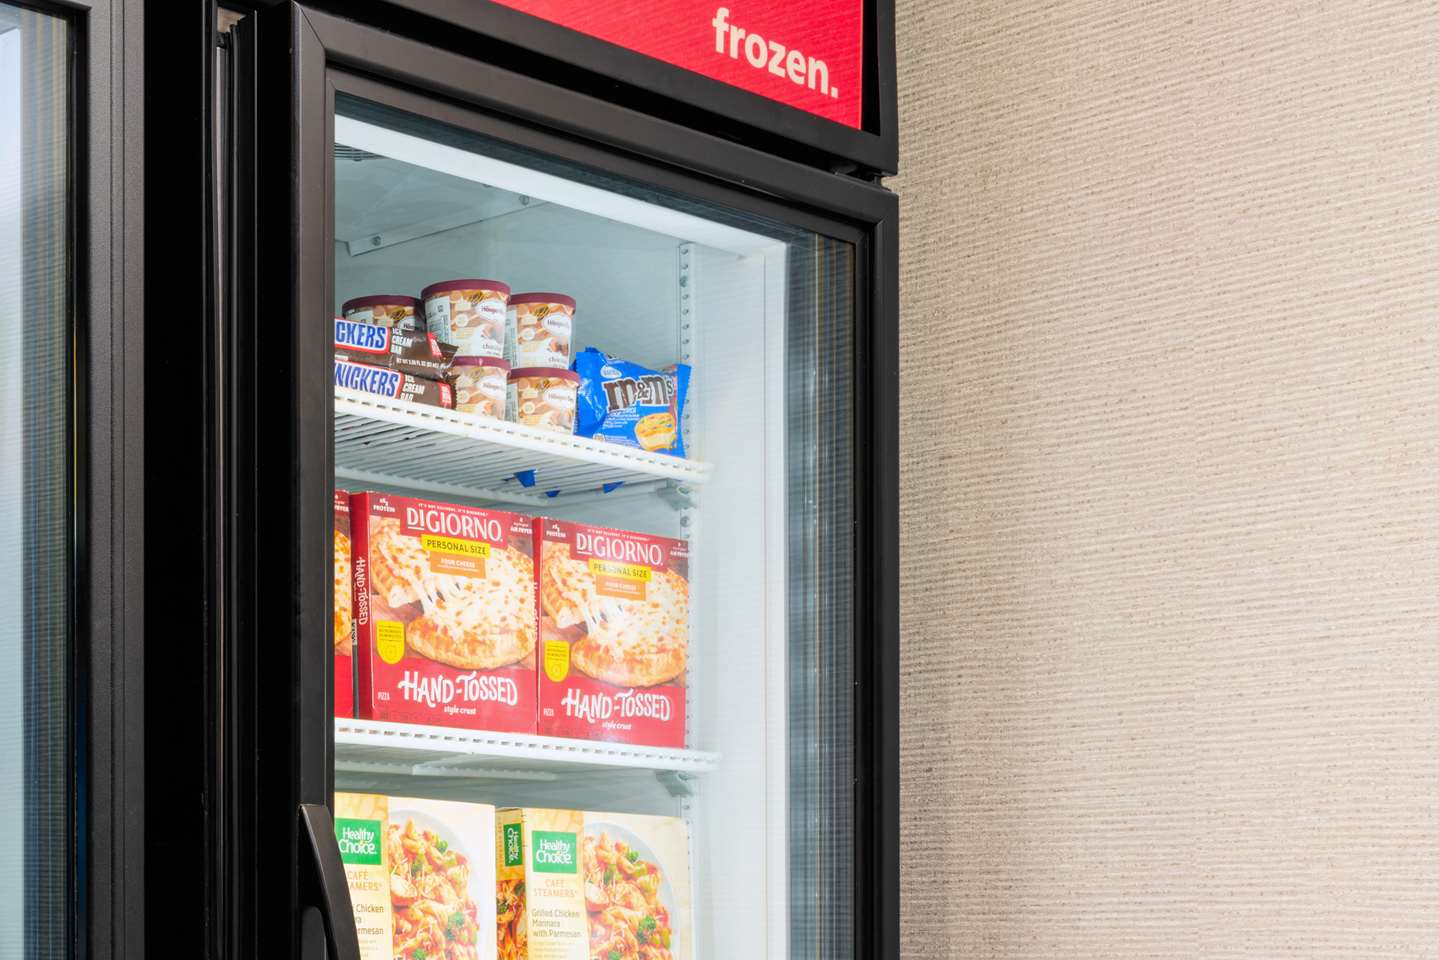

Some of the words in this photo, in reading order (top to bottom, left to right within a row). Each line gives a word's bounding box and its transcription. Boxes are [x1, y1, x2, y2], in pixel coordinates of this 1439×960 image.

[711, 7, 840, 99] frozen.
[336, 320, 387, 349] CKERS
[391, 335, 414, 348] CREAM
[335, 362, 400, 398] NICKERS
[402, 383, 426, 396] CREAM
[372, 504, 396, 514] PROTEIN
[426, 539, 470, 554] PERSONAL
[470, 543, 487, 555] SIZE
[456, 560, 476, 569] CHEESE
[632, 568, 649, 579] SIZE
[355, 556, 369, 626] HAND-TOSSED
[397, 669, 518, 708] HAND-TOSSED
[443, 704, 459, 716] style
[459, 706, 477, 715] crust
[560, 687, 671, 725] HAND-TOSSED
[342, 827, 375, 844] Healthy
[338, 838, 377, 856] Choice
[539, 838, 572, 854] Healthy
[535, 850, 573, 865] Choice
[533, 887, 576, 898] STEAMERS
[355, 903, 385, 914] Chicken
[531, 908, 553, 918] Grilled
[553, 908, 581, 919] Chicken
[532, 918, 561, 928] Marinara
[532, 928, 548, 938] with
[548, 928, 582, 939] Parmesan
